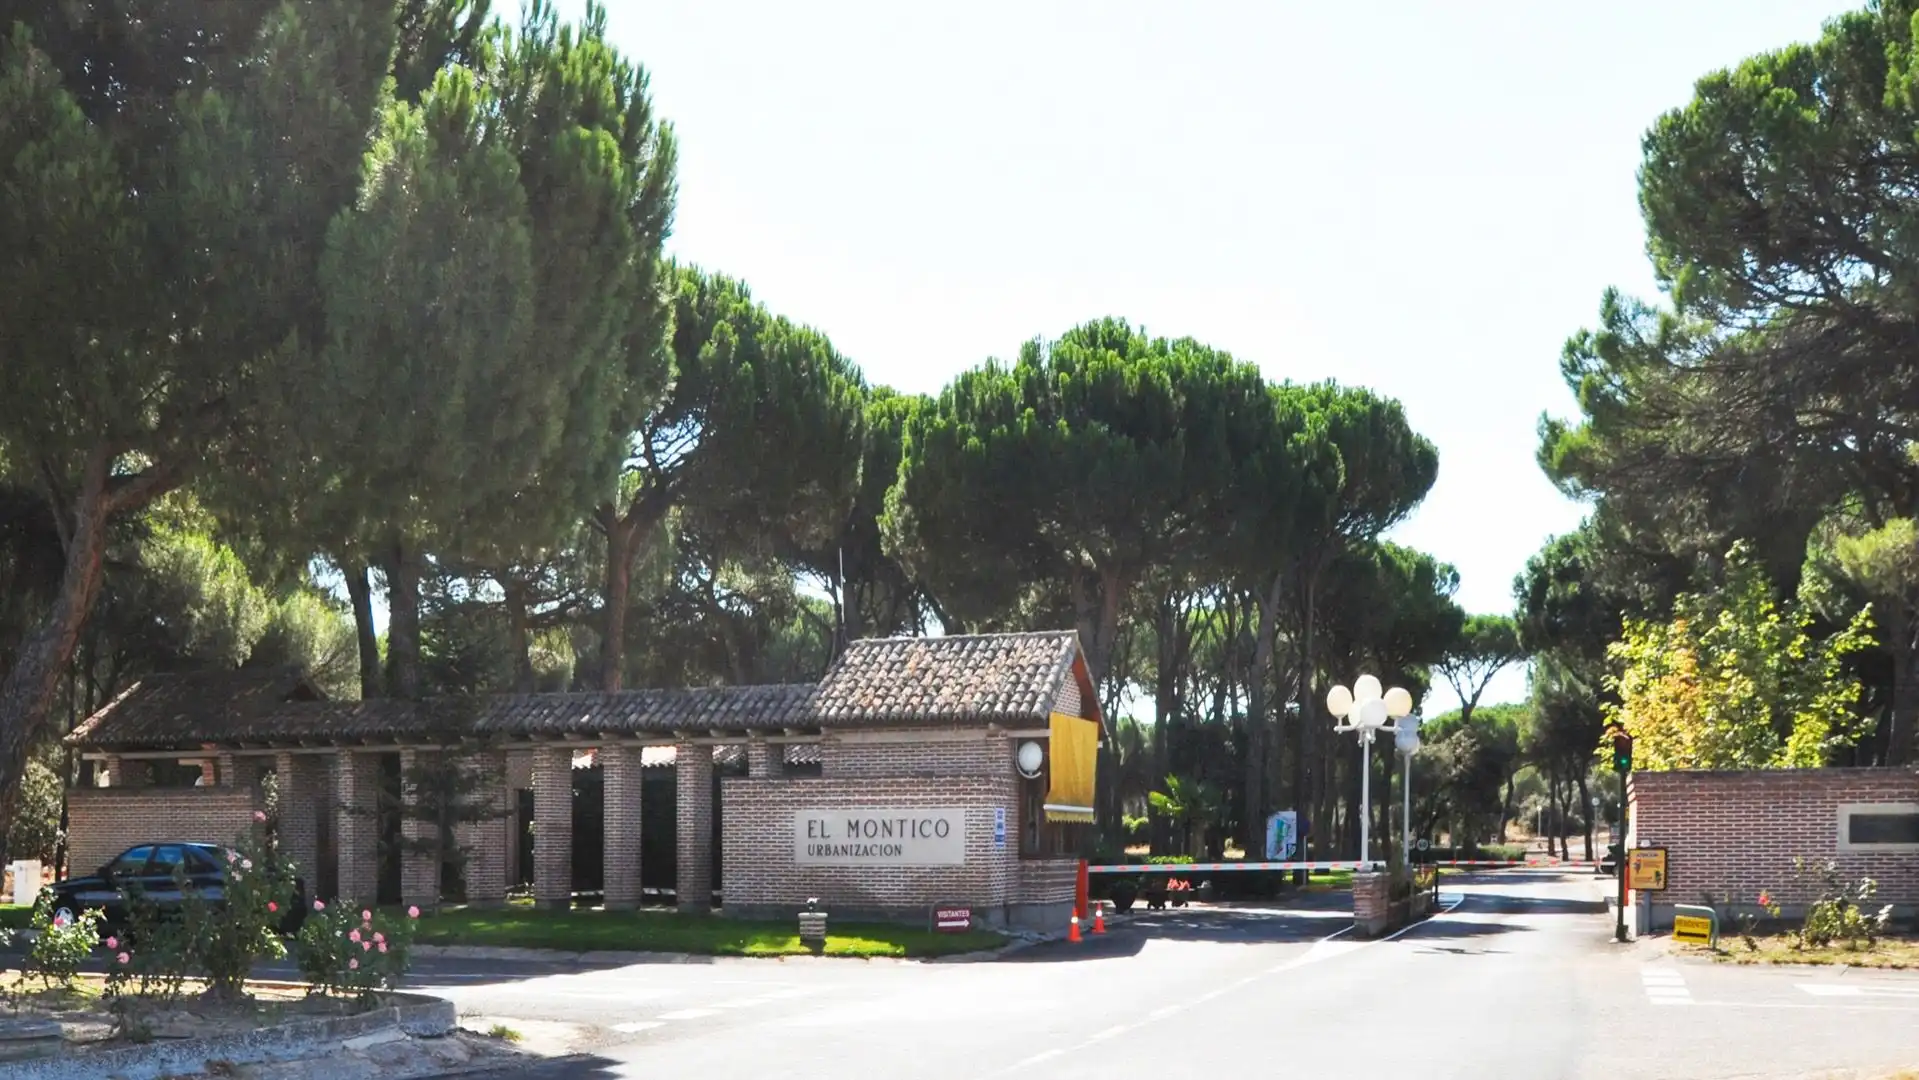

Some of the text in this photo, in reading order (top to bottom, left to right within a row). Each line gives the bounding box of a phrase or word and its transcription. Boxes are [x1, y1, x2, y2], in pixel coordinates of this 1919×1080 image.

[807, 818, 950, 839] EL MONTICO
[807, 843, 903, 857] URBANIZACION
[937, 910, 970, 919] VISITANTES
